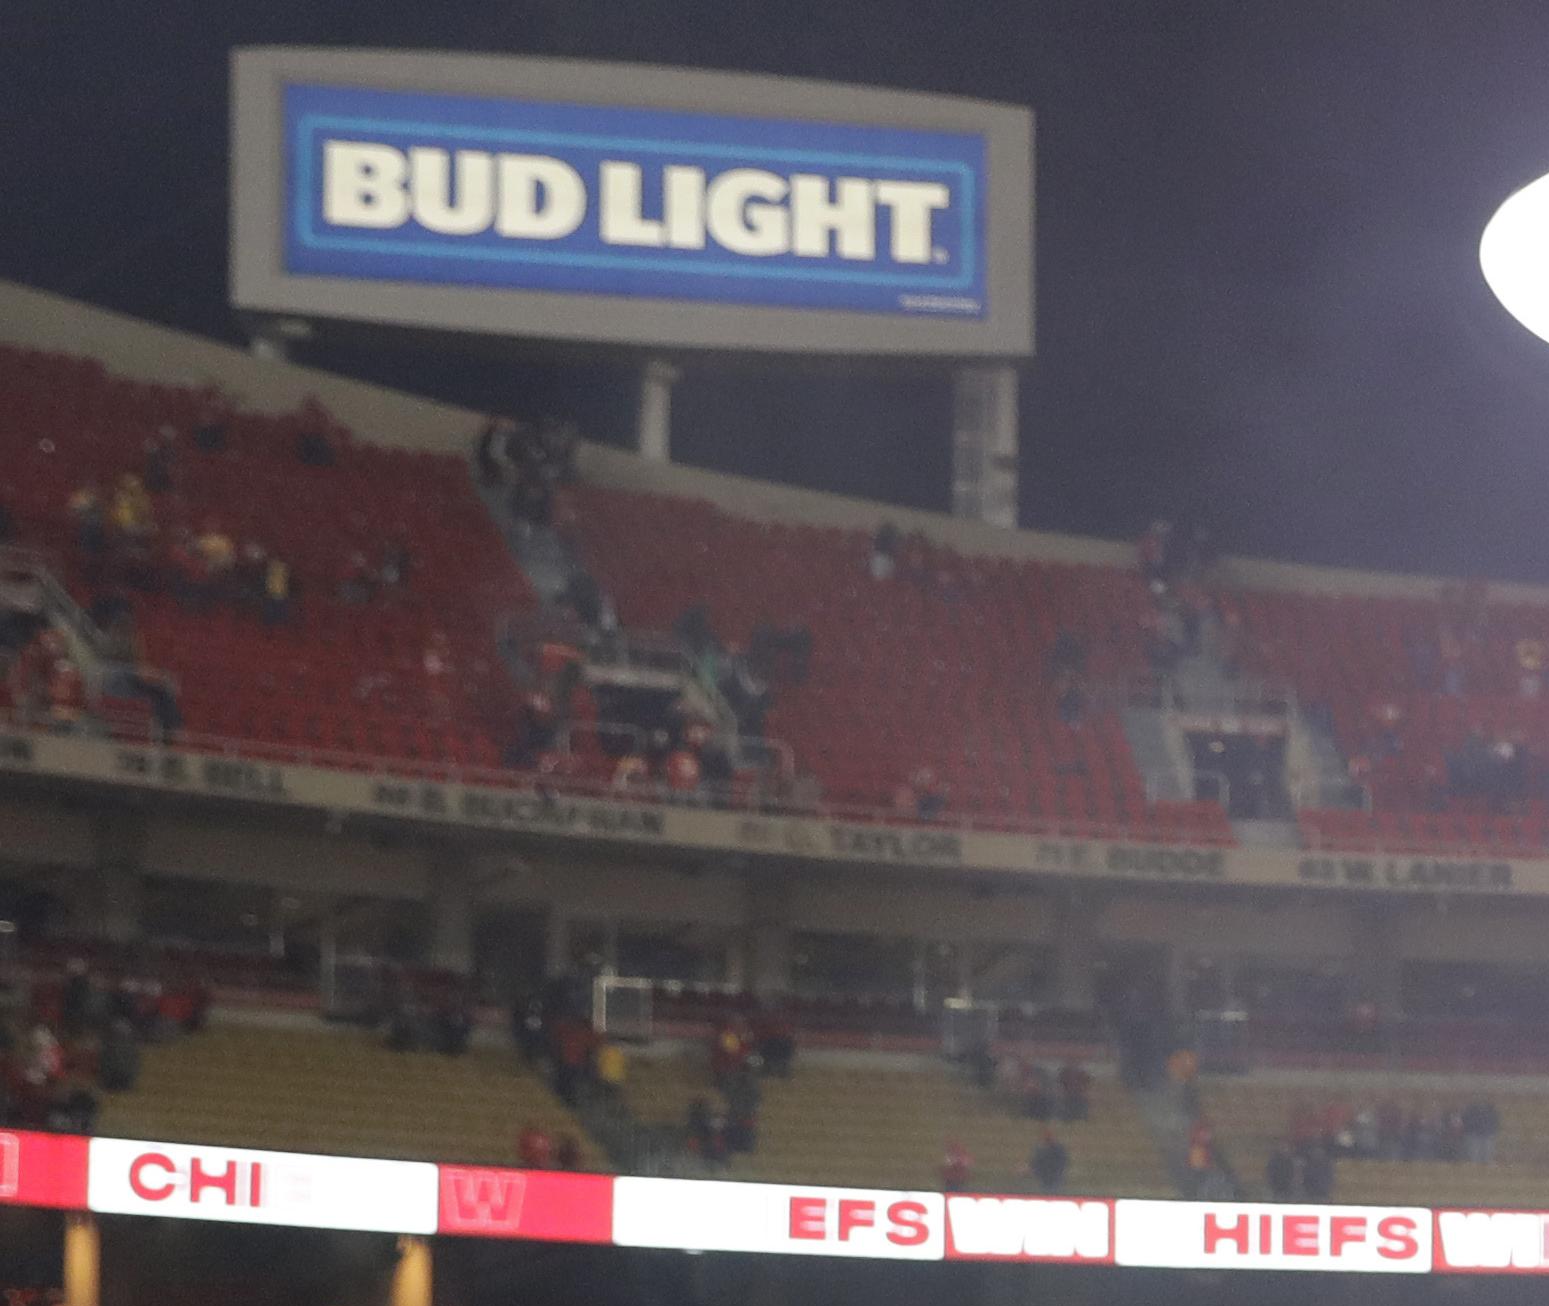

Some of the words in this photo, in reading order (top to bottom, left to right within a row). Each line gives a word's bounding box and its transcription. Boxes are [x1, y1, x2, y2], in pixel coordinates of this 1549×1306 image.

[321, 139, 586, 240] BUD
[599, 161, 950, 266] LIGHT
[129, 1152, 262, 1208] CHI
[443, 1166, 527, 1231] W
[788, 1196, 930, 1247] EFS
[947, 1196, 1110, 1259] WIN
[1203, 1212, 1419, 1261] HIEFS
